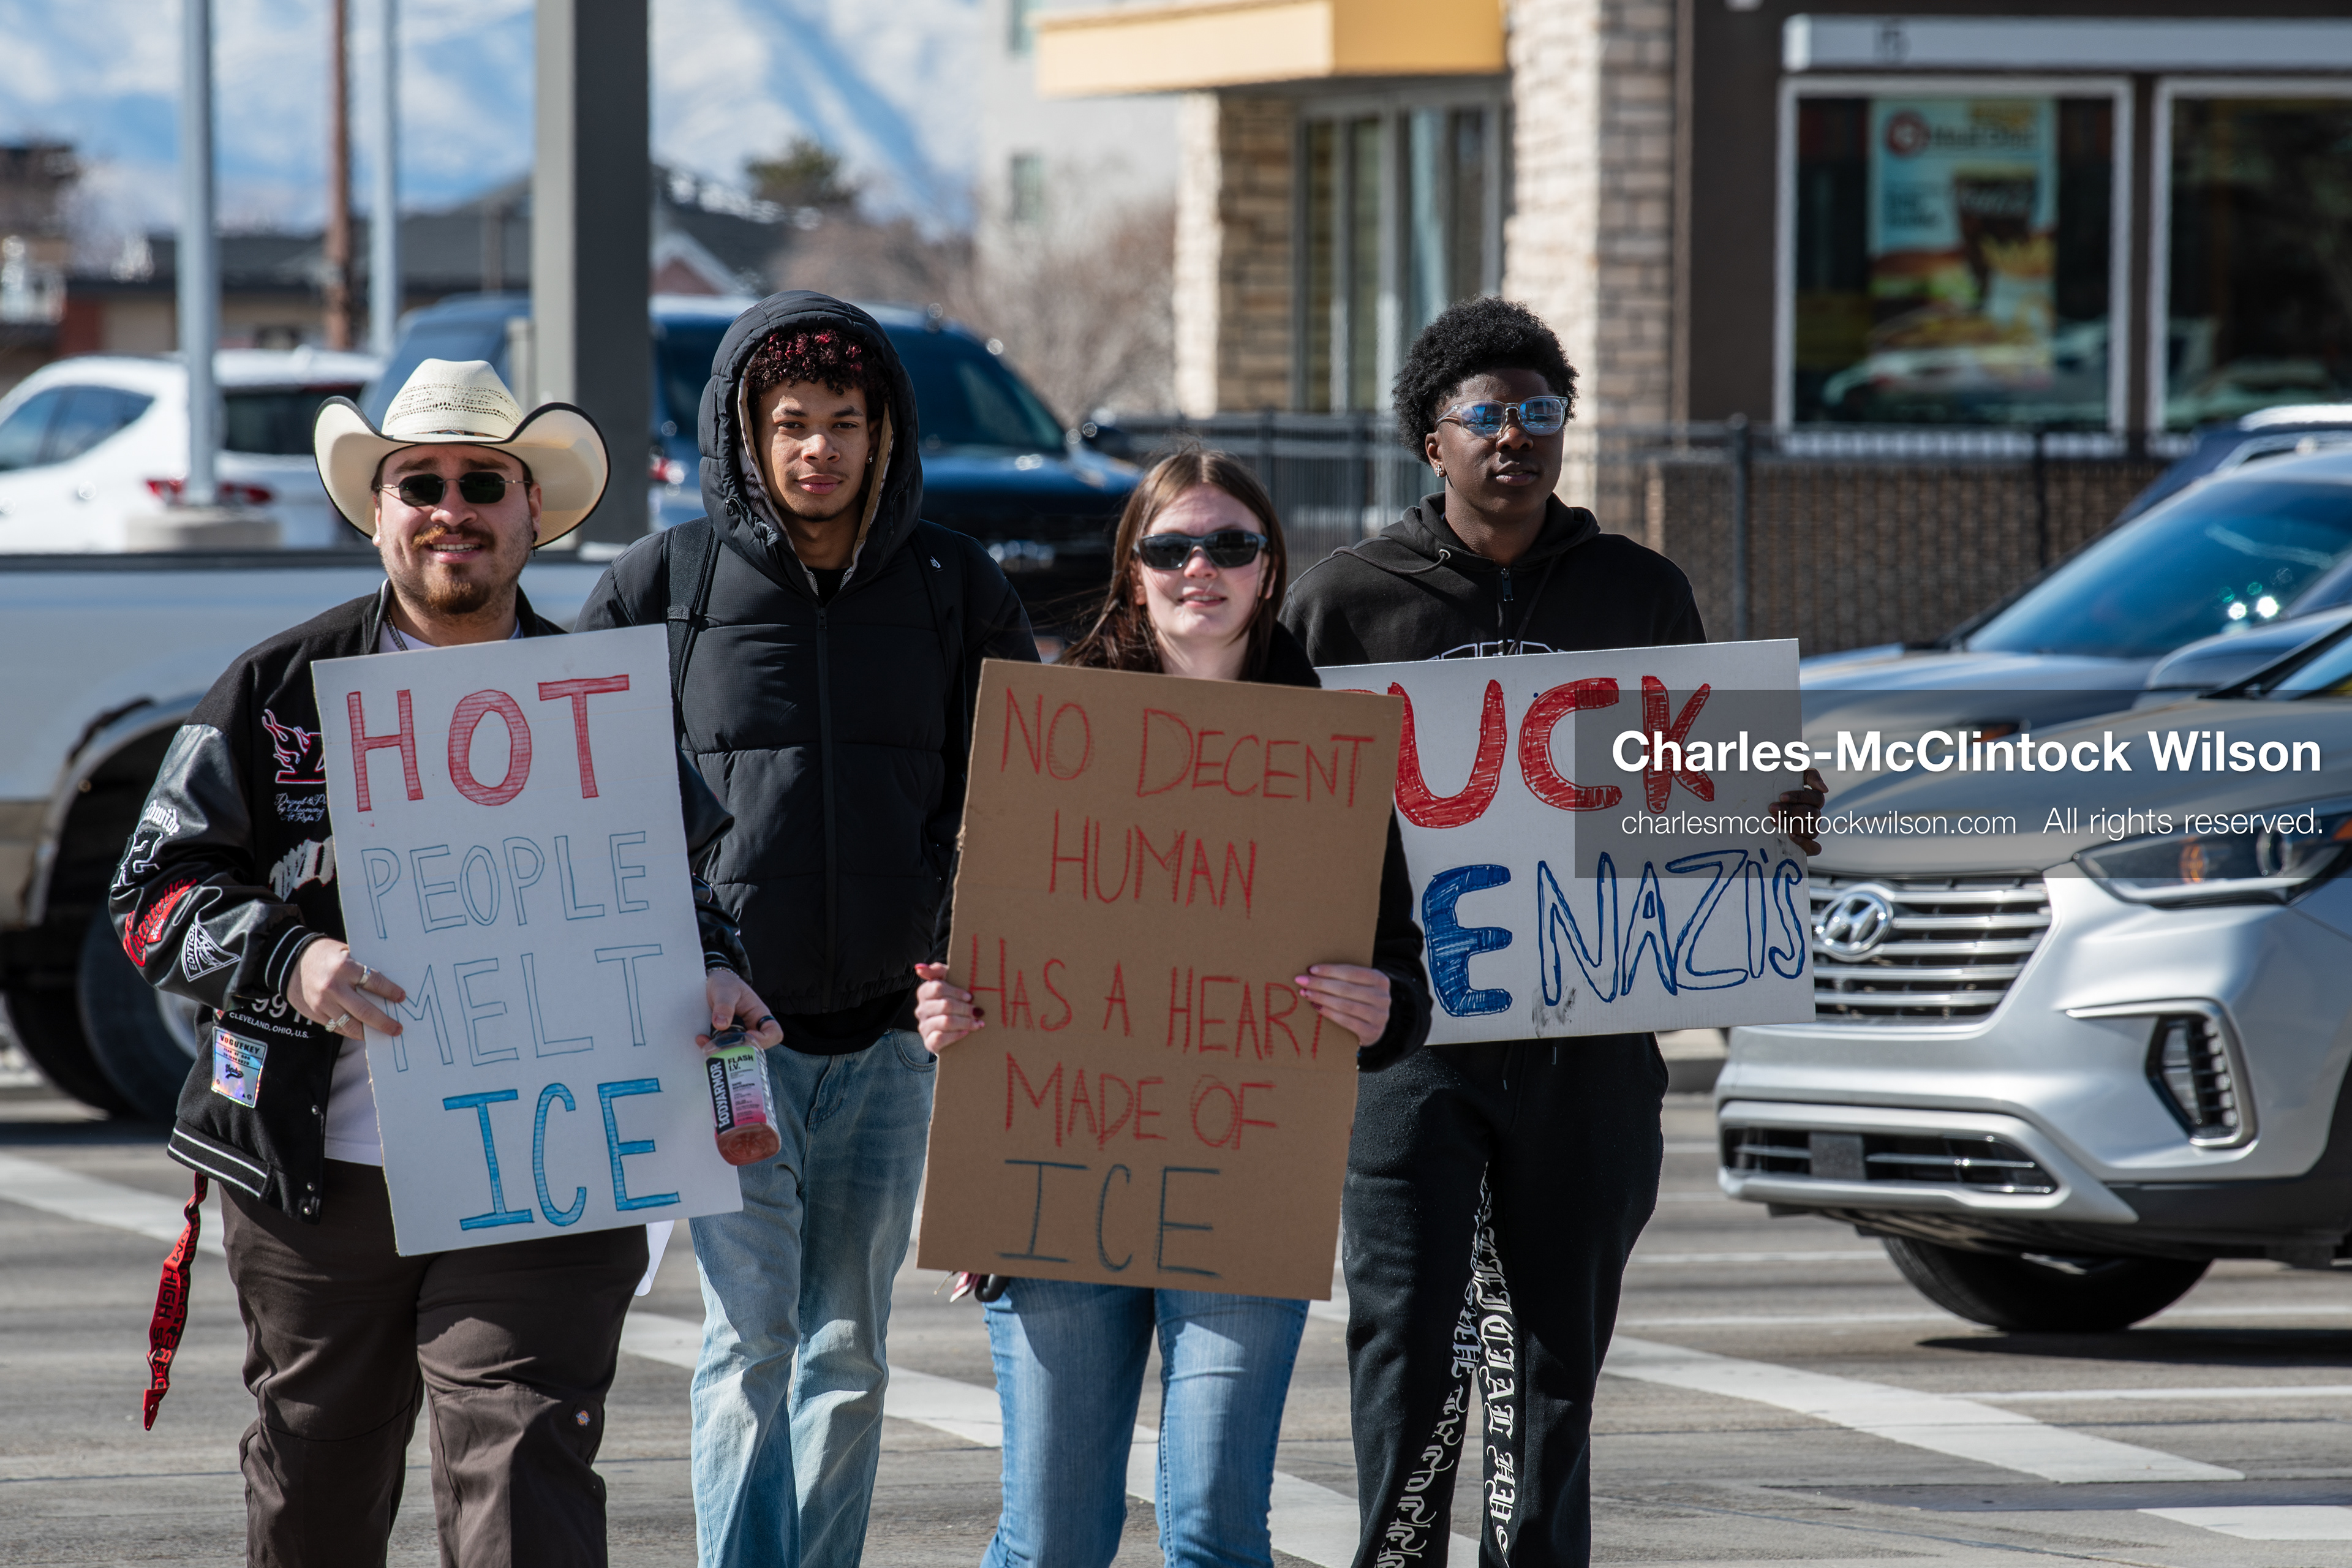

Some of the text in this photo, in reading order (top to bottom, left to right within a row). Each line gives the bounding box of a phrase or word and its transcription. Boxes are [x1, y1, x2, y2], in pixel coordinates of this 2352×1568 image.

[347, 674, 630, 813] HOT
[1001, 687, 1376, 808] NO DECENT
[1335, 675, 1715, 829] UCK
[361, 831, 650, 940] PEOPLE
[1048, 808, 1257, 918] HUMAN
[185, 924, 197, 971] EDITION
[968, 933, 1073, 1032] HAS
[1102, 960, 1132, 1036] A
[220, 1034, 260, 1055] VOGUEKEY
[385, 944, 663, 1072] MELT
[728, 1054, 754, 1065] FLASH
[443, 1079, 680, 1231] ICE
[1005, 1051, 1276, 1151] MADE OF
[996, 1159, 1222, 1278] ICE
[159, 1266, 177, 1319] HIGH
